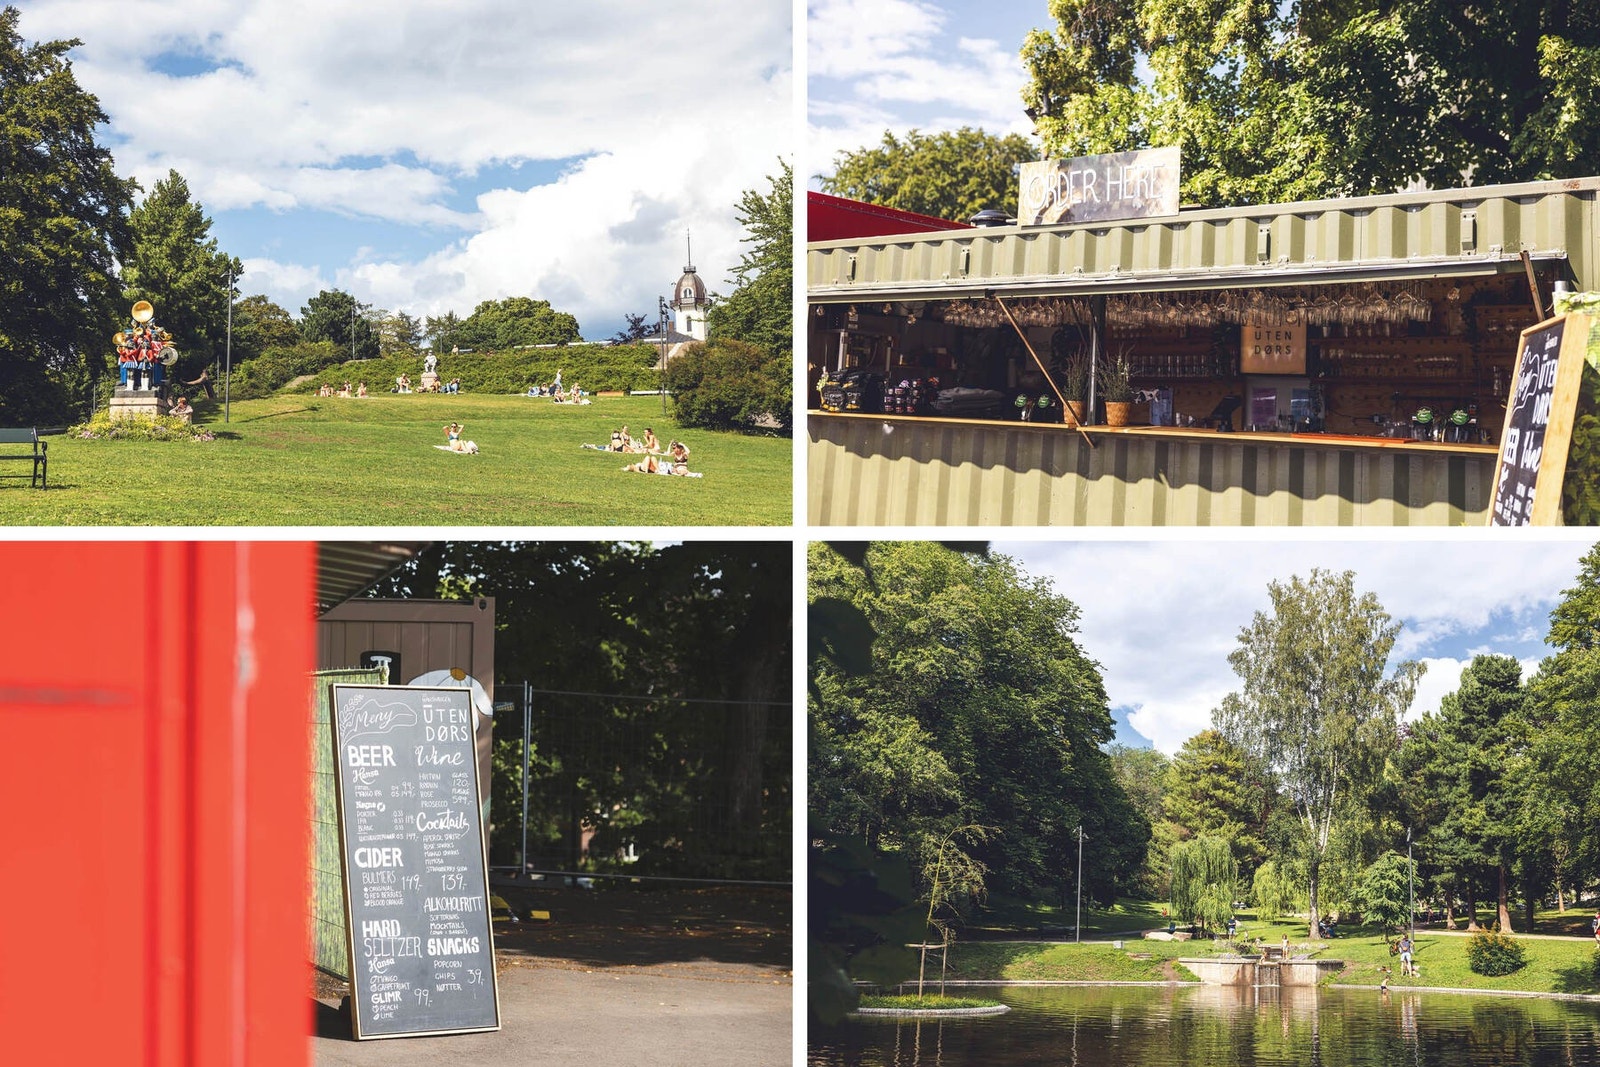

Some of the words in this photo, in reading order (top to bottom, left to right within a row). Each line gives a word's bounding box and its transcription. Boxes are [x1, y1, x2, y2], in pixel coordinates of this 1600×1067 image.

[1024, 168, 1099, 211] ORDER
[1106, 164, 1165, 201] HERE
[1254, 331, 1292, 340] UTEN
[1254, 345, 1292, 355] DØRS
[354, 710, 393, 732] Meny
[426, 725, 469, 742] DØRS
[347, 745, 396, 767] BEER
[415, 745, 465, 767] Wine
[352, 767, 380, 785] Hansa
[421, 800, 448, 808] PROSECCO
[416, 808, 470, 837] Cocktails
[354, 847, 404, 868] CIDER
[362, 871, 396, 885] BULMERS
[441, 874, 468, 892] 139,-
[423, 896, 482, 913] ALKOHOLFRITT
[362, 919, 401, 938] HARD
[430, 921, 465, 930] MOCKTAILS
[363, 936, 423, 958] SELTZER
[427, 937, 480, 956] SNACKS
[367, 956, 395, 974] Hansa
[433, 960, 463, 969] POPCORN
[377, 975, 398, 984] MANGO
[434, 972, 456, 980] CHIPS
[436, 983, 462, 992] NØTTER
[371, 991, 402, 1004] GLIMR
[380, 1012, 394, 1020] LIME
